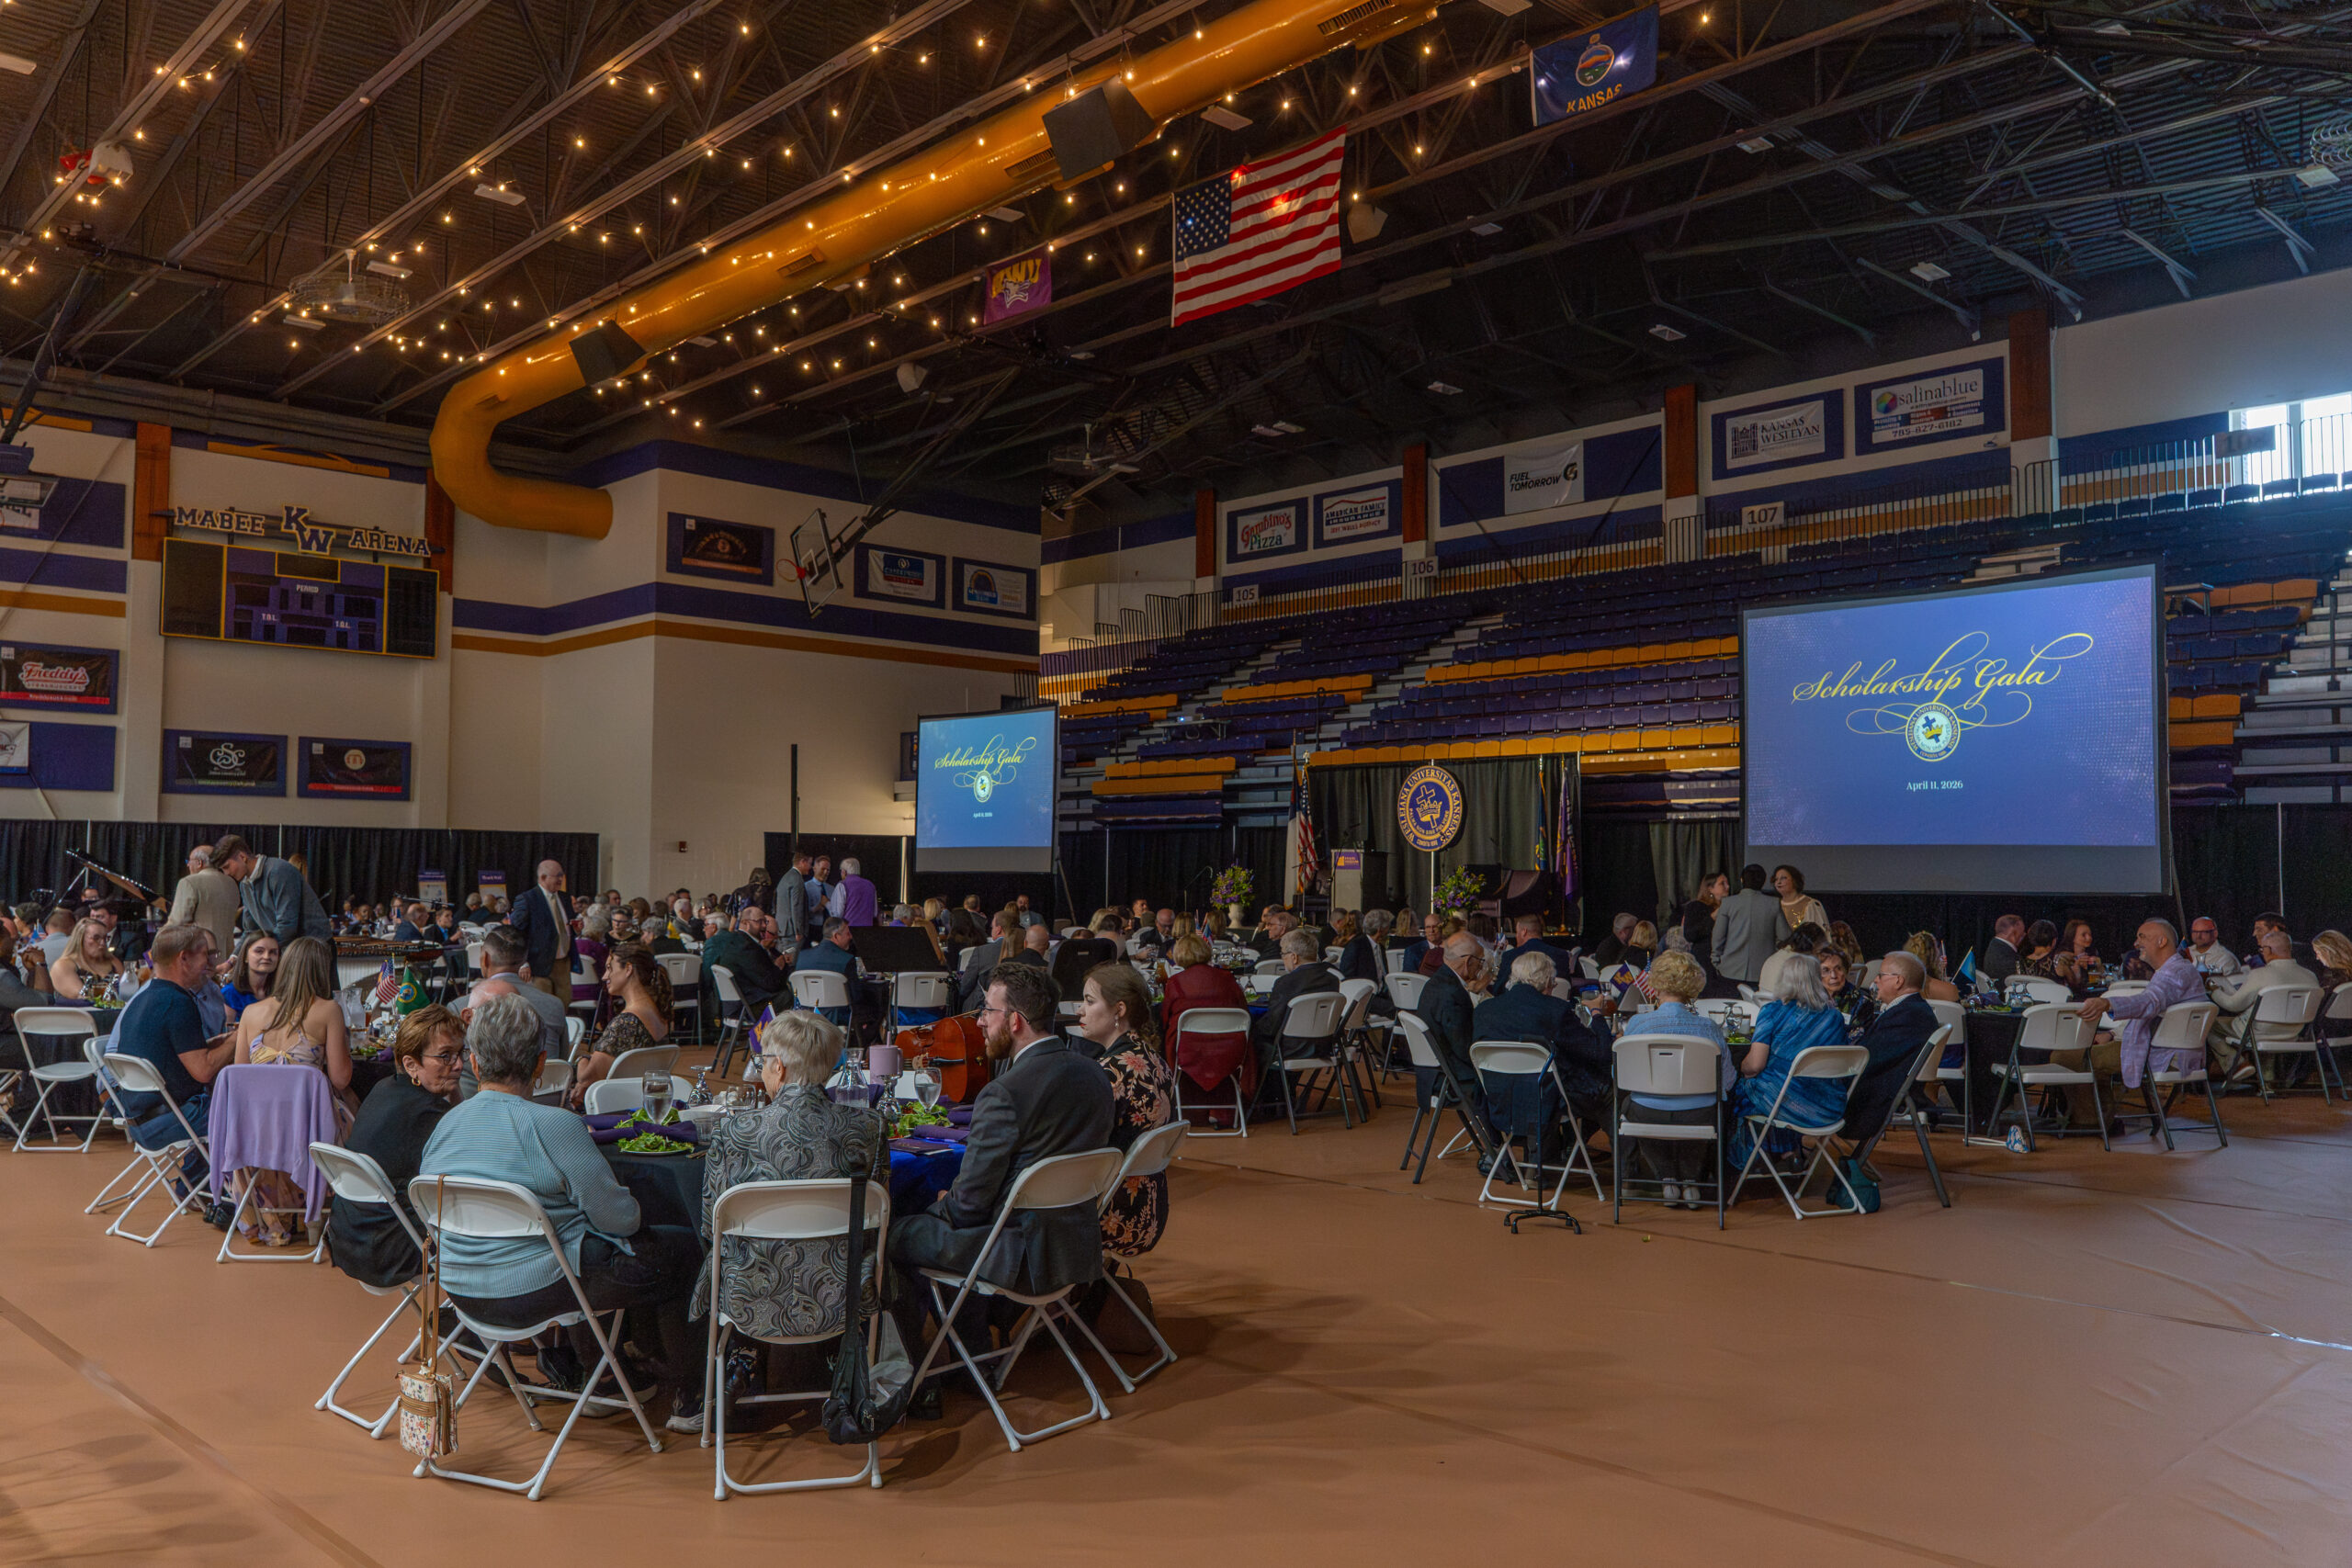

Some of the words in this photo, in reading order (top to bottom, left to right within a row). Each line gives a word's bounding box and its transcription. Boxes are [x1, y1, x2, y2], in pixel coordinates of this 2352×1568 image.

[1566, 83, 1623, 114] KANSAS
[1898, 377, 1978, 406] salinablue
[1760, 415, 1805, 434] KANSAS
[1761, 424, 1820, 444] WESLEYAN
[1510, 471, 1530, 483] FUEL
[1510, 475, 1561, 492] TOMORROW
[1326, 506, 1359, 518] AMERICAN
[1361, 502, 1385, 512] FAMILY
[1747, 507, 1779, 525] 107
[174, 505, 266, 536] MABEE
[348, 529, 431, 558] ARENA
[1241, 513, 1292, 548] Gambino's
[1250, 535, 1283, 550] Pizza
[1411, 559, 1434, 576] 106
[1236, 588, 1255, 603] 105
[18, 661, 90, 685] Freddy's
[1791, 631, 1989, 705] Scholarship
[1963, 632, 2094, 711] Gala
[933, 733, 1004, 772] Scholarship
[993, 736, 1037, 775] Gala
[1906, 780, 1928, 793] April
[1930, 780, 1939, 791] 11,
[1940, 780, 1963, 790] 2026
[1399, 787, 1415, 842] WESLEIANA
[1407, 769, 1455, 791] UNIVERSITAS
